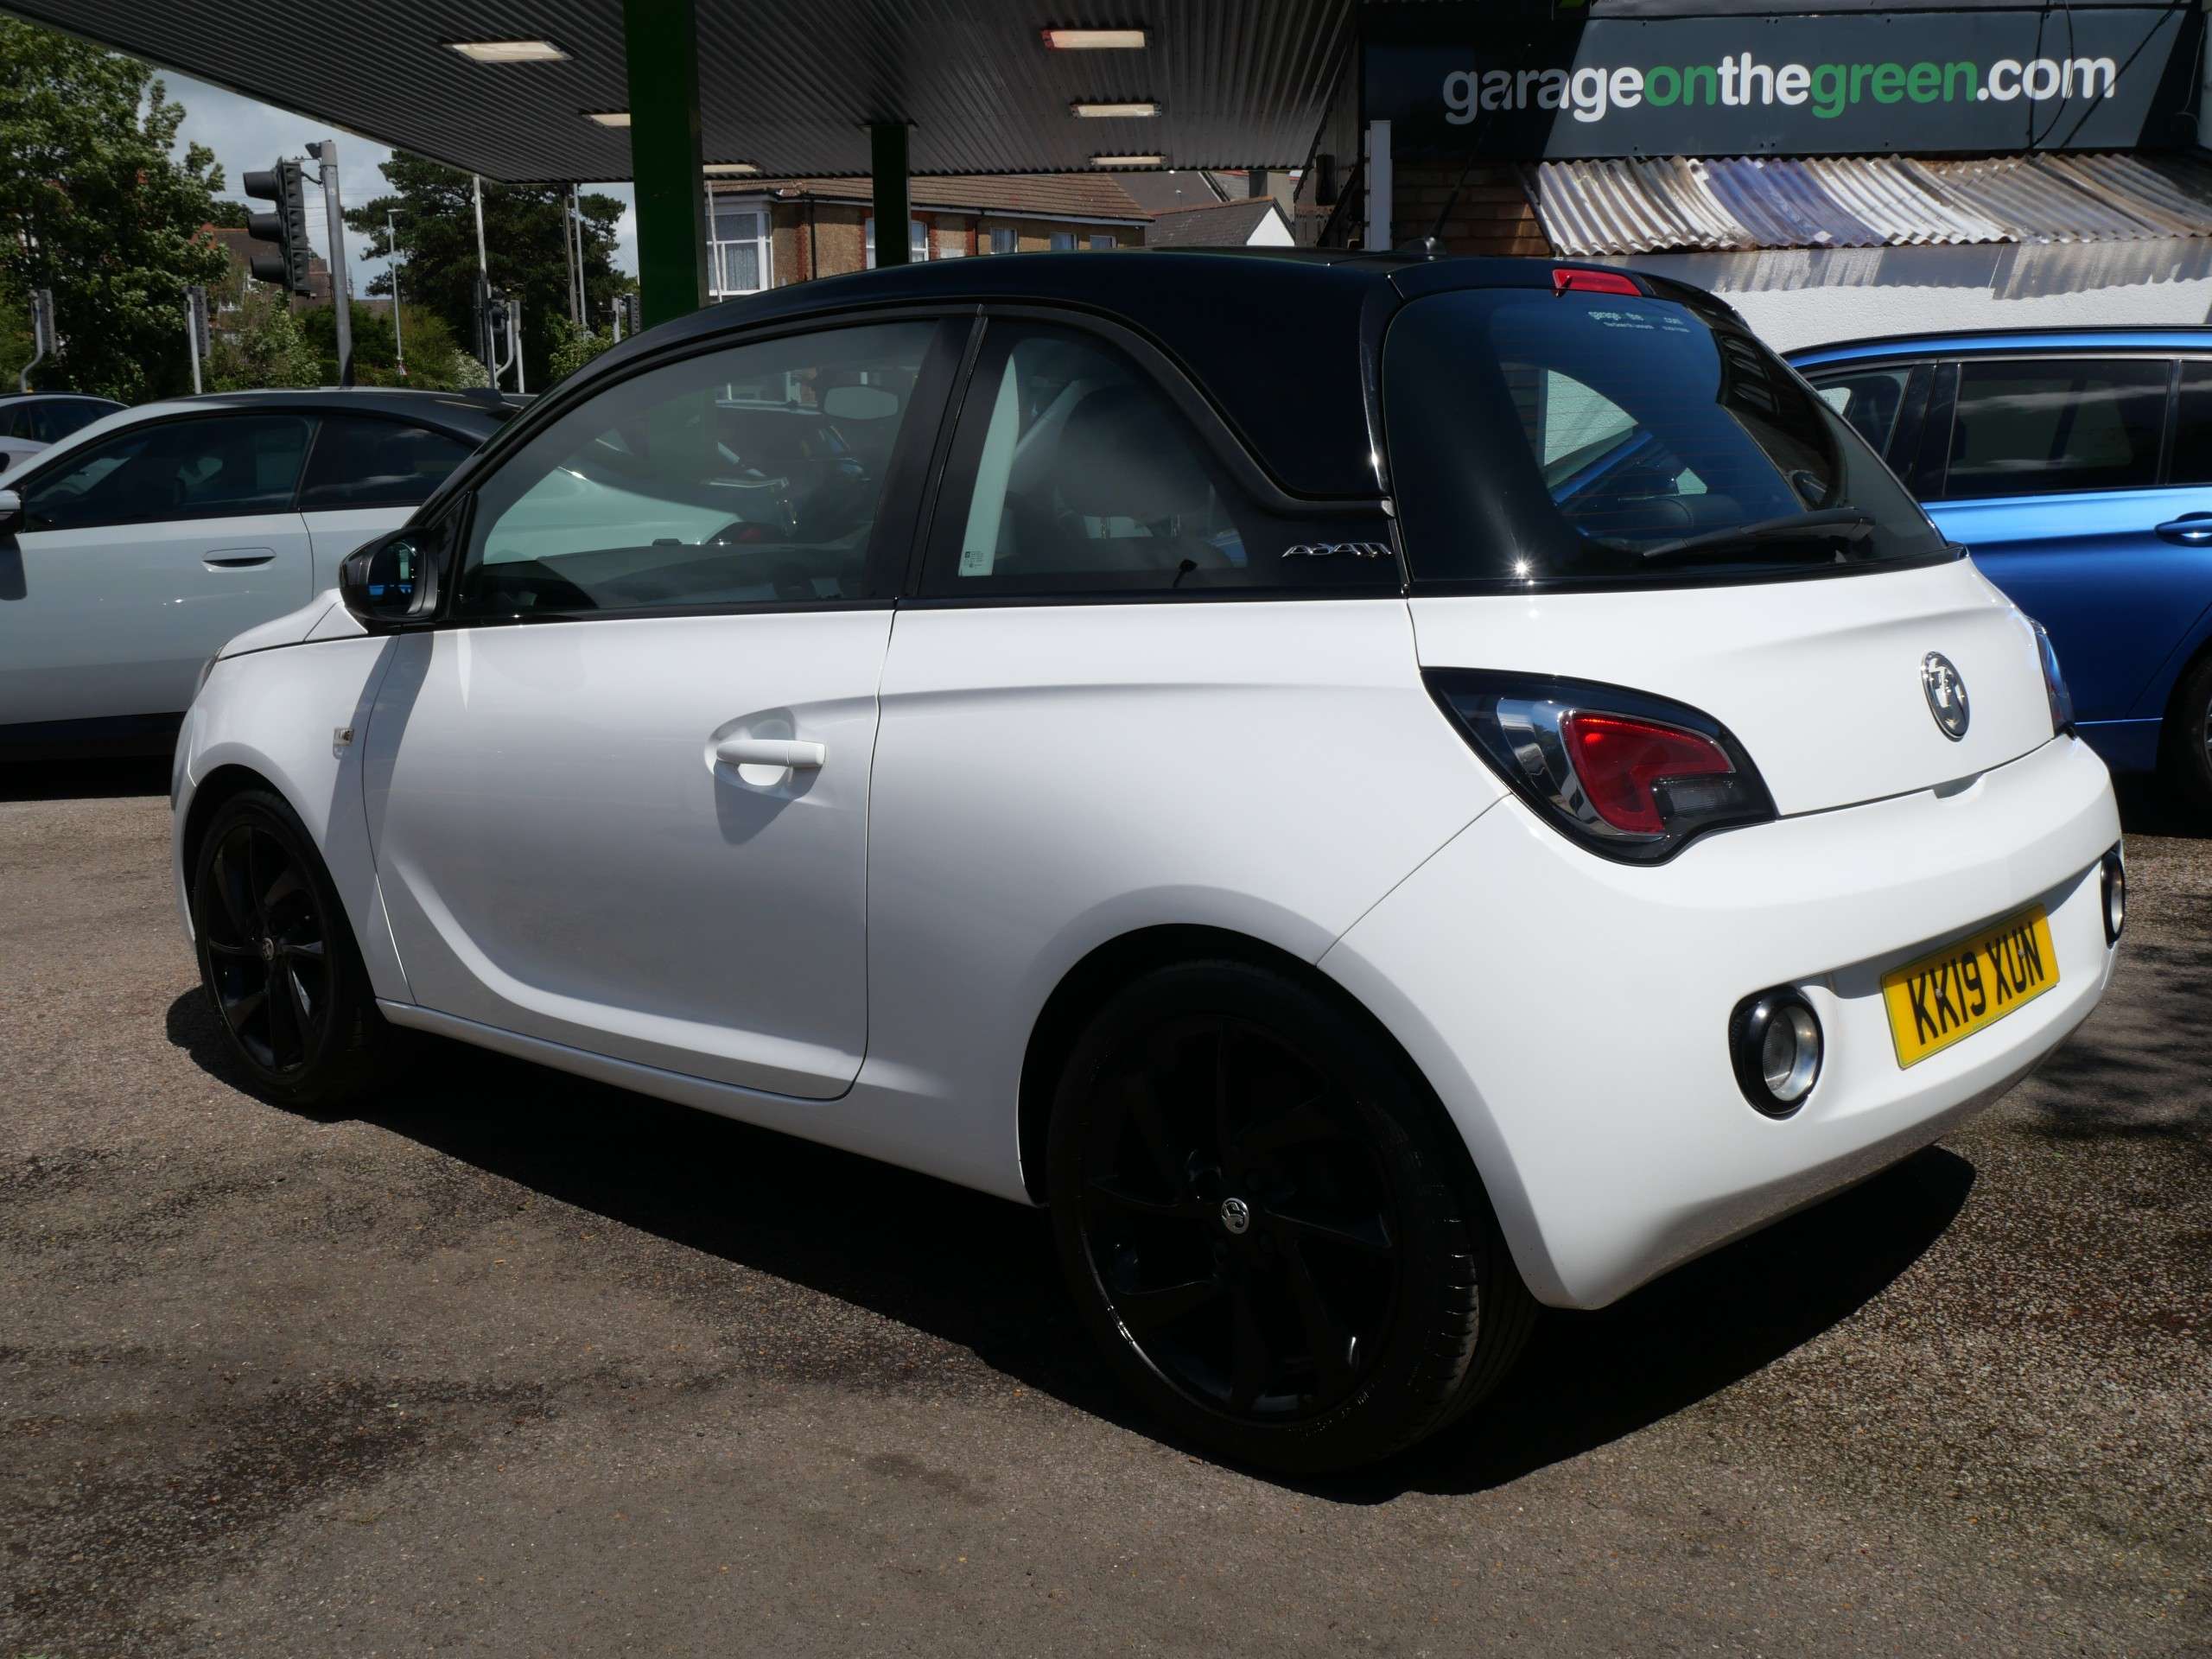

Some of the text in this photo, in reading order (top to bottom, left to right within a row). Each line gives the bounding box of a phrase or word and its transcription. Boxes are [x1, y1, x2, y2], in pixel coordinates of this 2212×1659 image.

[1442, 51, 2116, 125] garageonthegreen.com
[1906, 921, 2045, 1046] KK19 XUN
